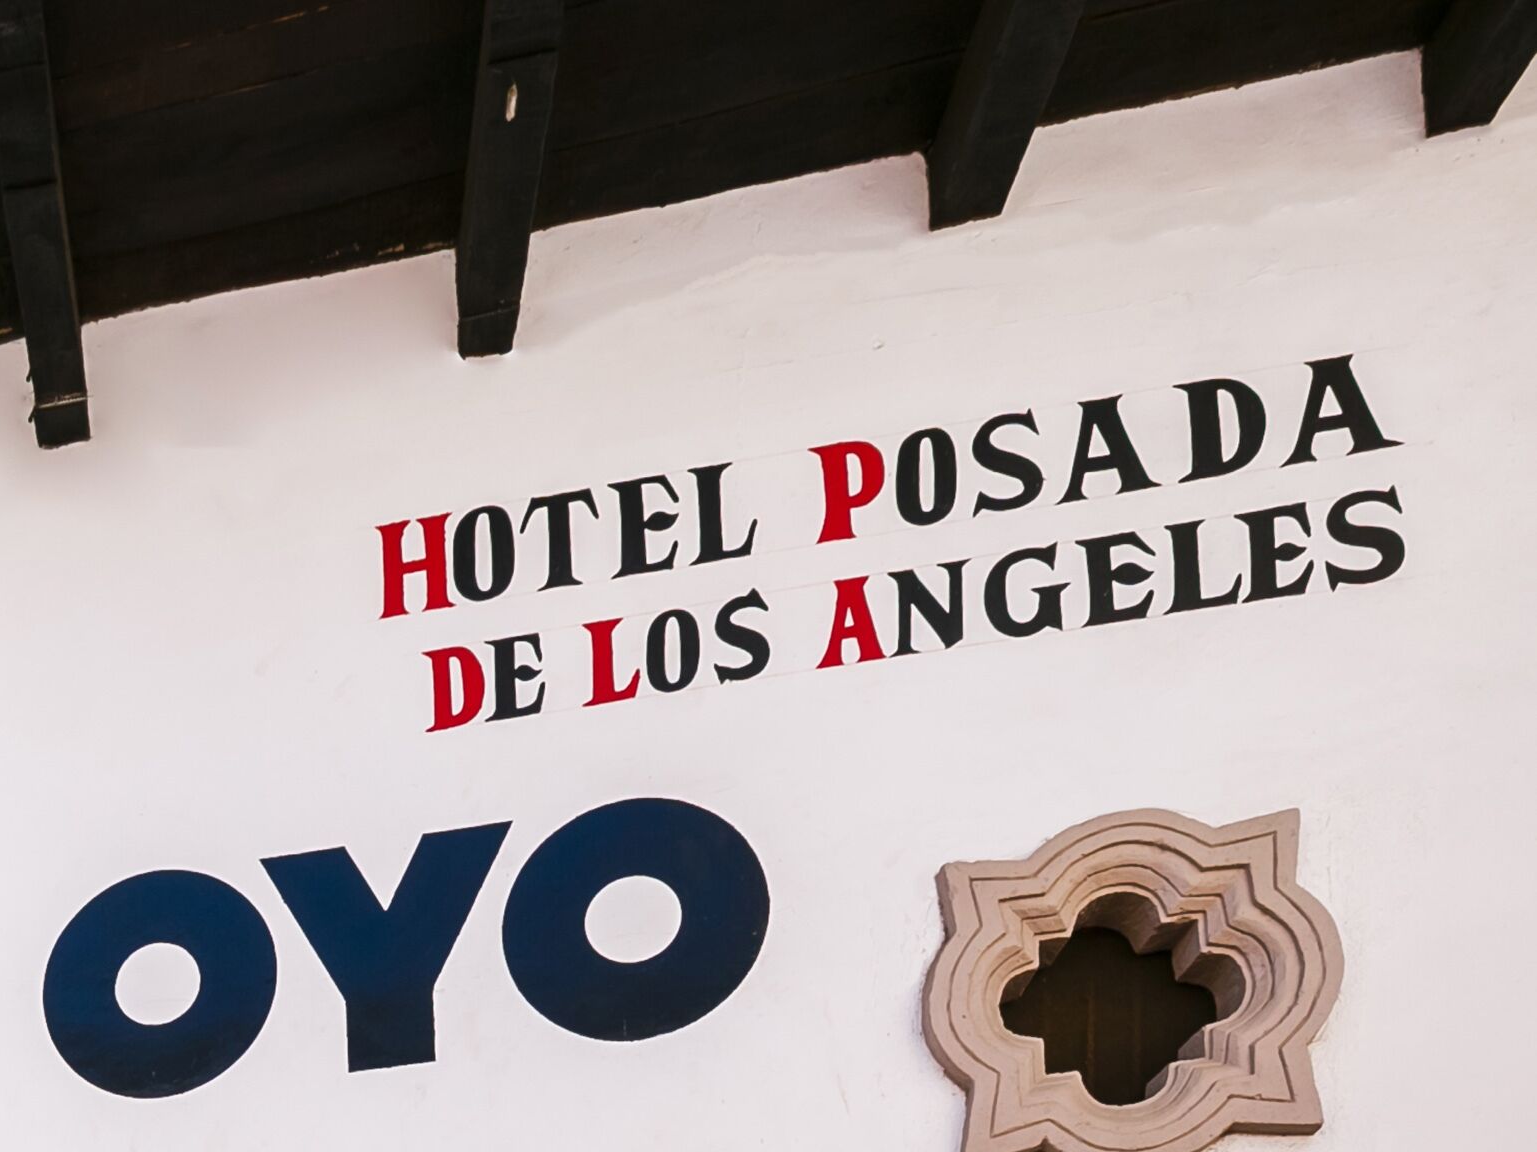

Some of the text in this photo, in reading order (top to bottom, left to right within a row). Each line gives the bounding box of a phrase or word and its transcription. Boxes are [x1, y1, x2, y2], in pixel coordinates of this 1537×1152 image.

[376, 354, 1404, 618] HOTEL POSADA
[423, 486, 1404, 732] DE LOS ANGELES
[43, 797, 770, 1098] OYO
